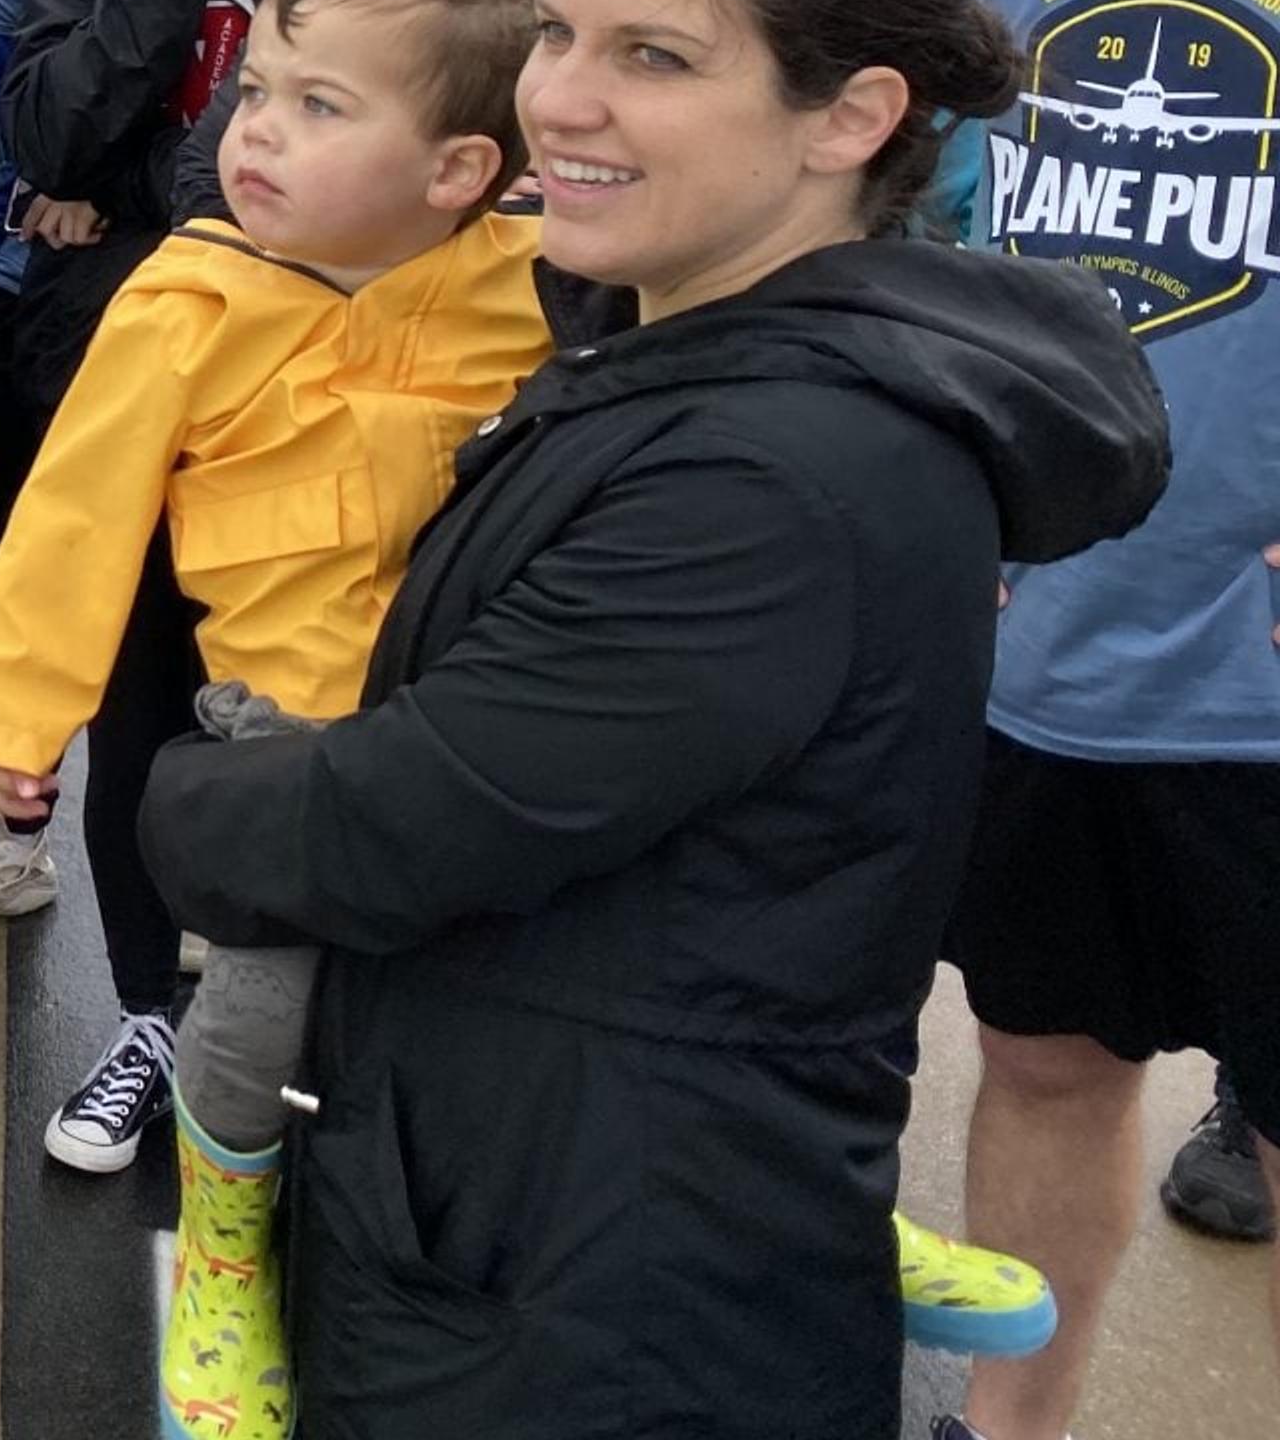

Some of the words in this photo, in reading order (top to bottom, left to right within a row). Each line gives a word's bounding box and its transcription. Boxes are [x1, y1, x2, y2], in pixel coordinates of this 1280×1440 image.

[207, 17, 232, 106] ACADEM
[1097, 36, 1125, 60] 20
[1188, 43, 1212, 67] 19
[991, 133, 1141, 240] PLANE
[1145, 172, 1280, 272] PUL
[1141, 265, 1191, 300] ILLINOIS
